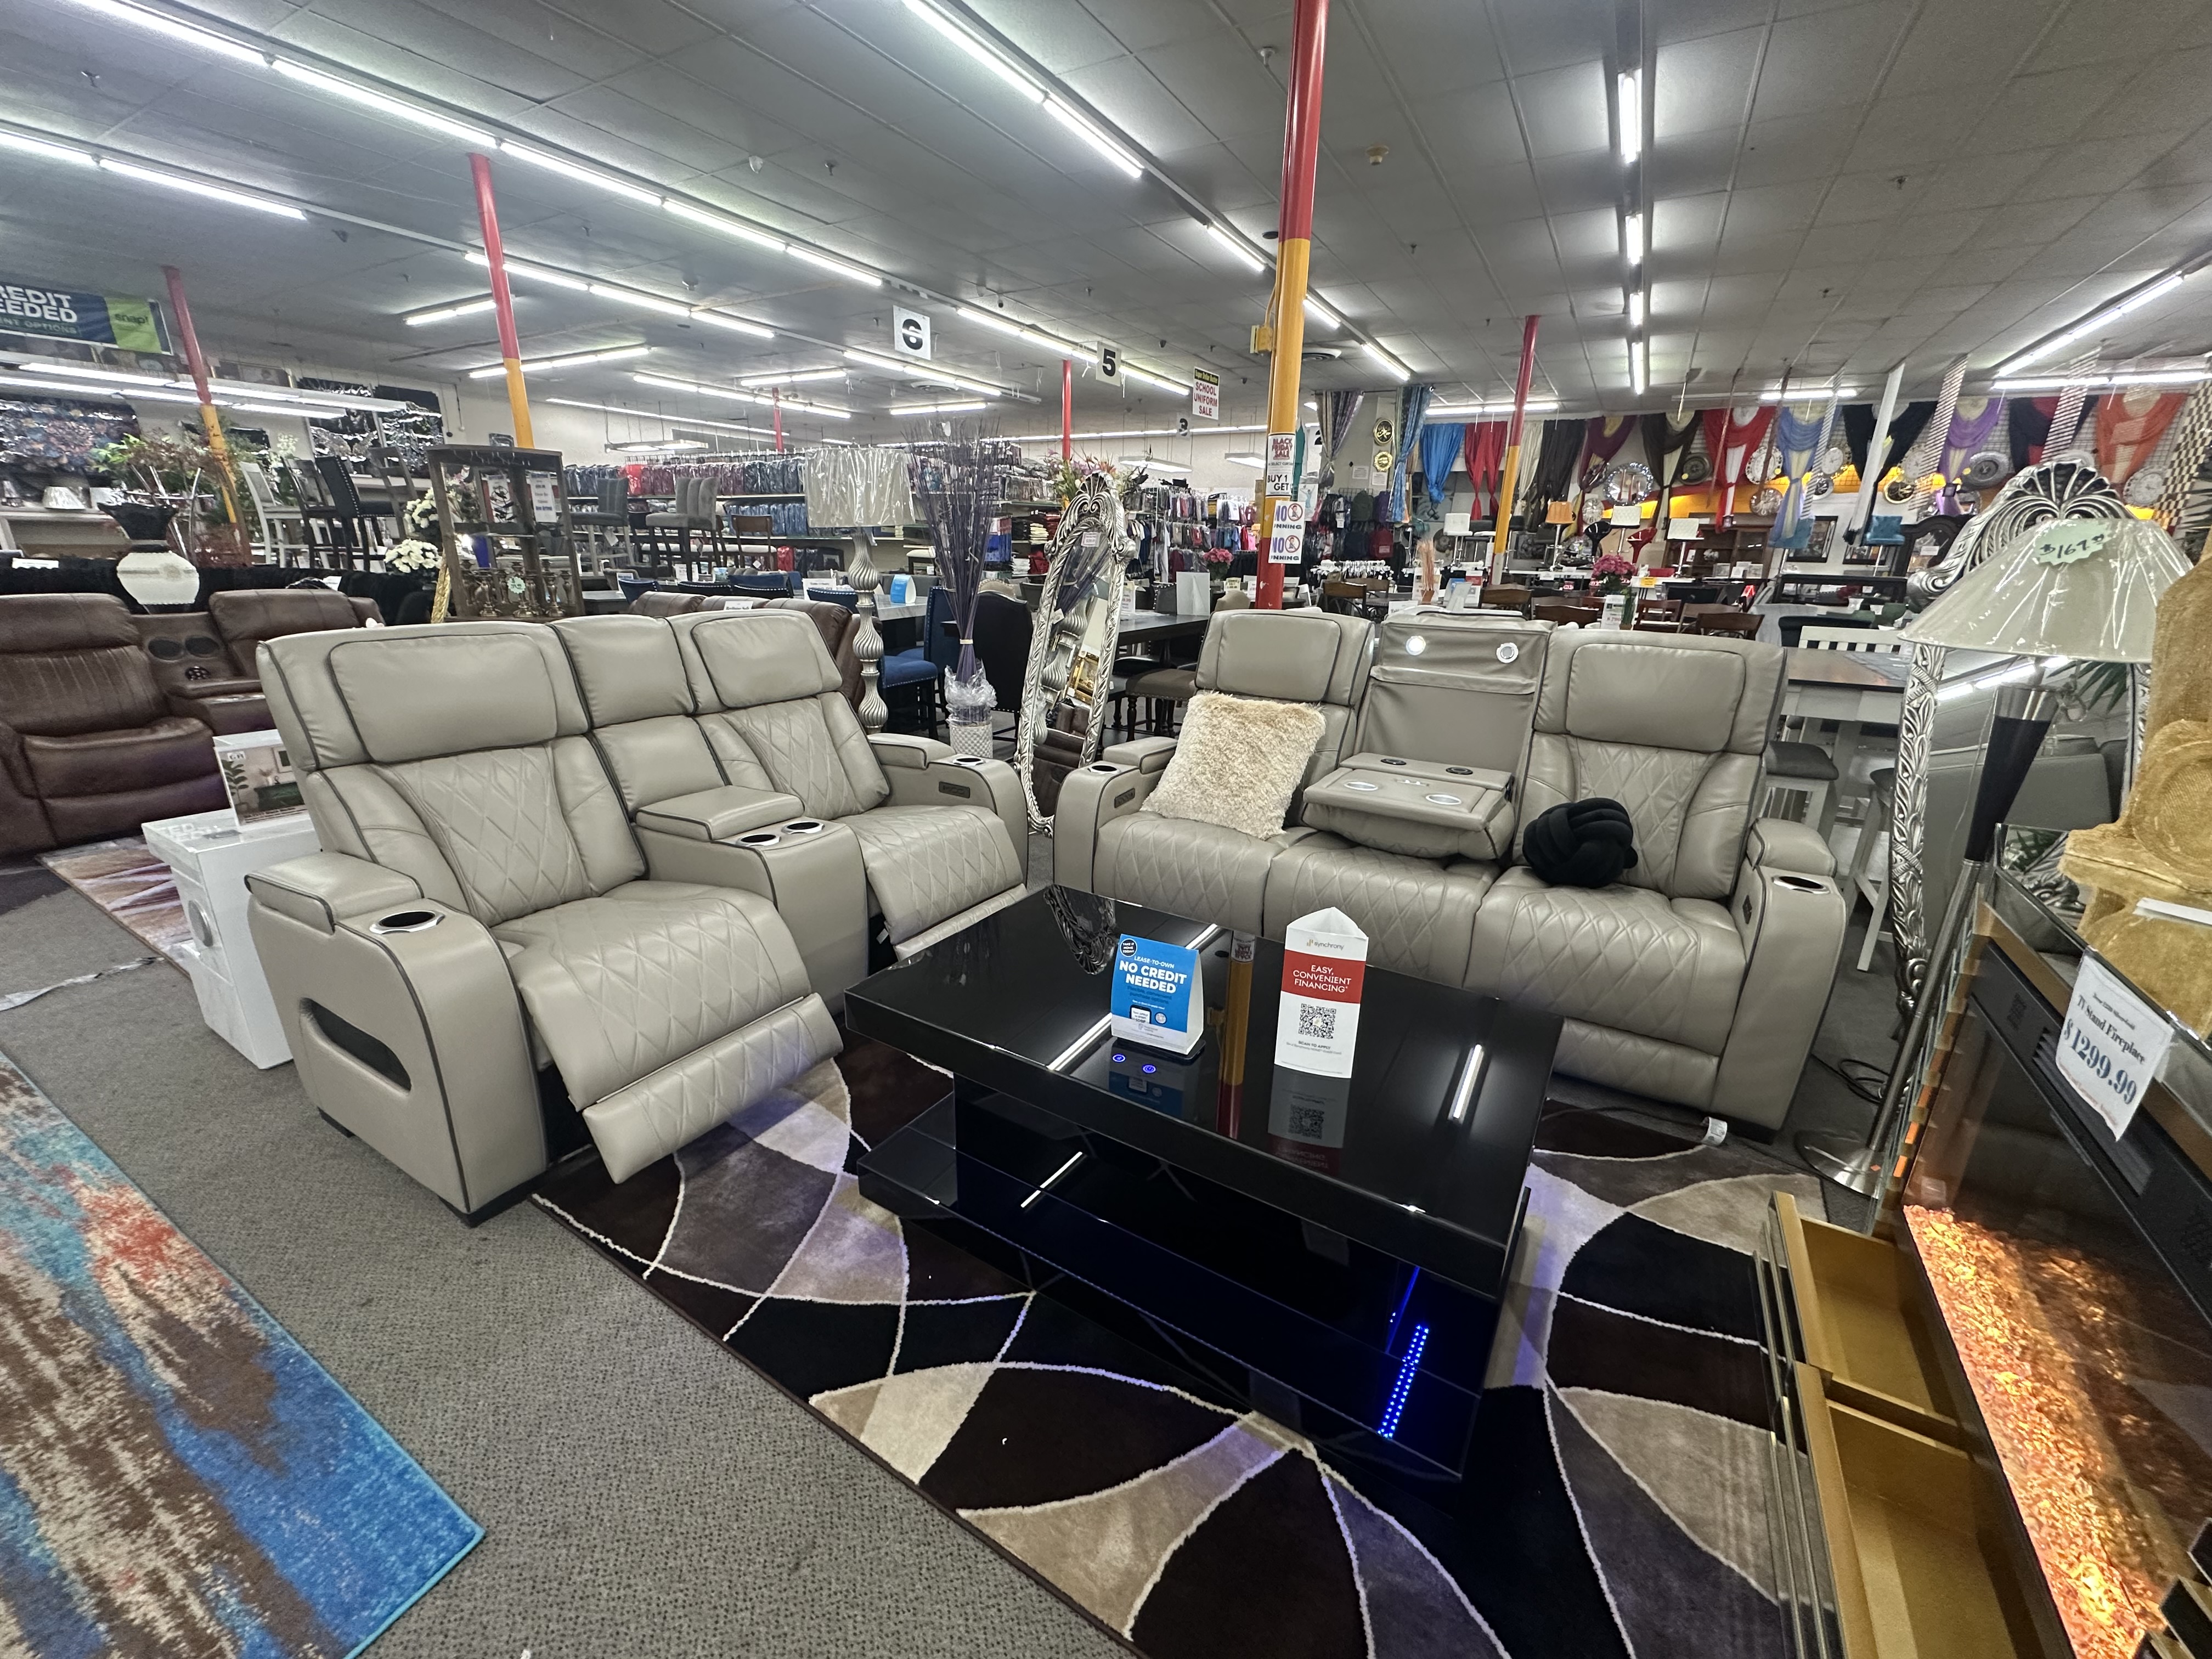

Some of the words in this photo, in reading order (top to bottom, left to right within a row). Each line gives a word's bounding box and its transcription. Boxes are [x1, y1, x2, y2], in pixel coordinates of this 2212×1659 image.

[901, 319, 923, 351] 6
[1102, 348, 1116, 377] 5
[1195, 382, 1216, 396] SCHOOL
[1194, 393, 1217, 407] UNIFORM
[1199, 405, 1212, 416] SALE
[1179, 418, 1188, 436] 3
[1272, 443, 1293, 451] FRIDAY
[1274, 449, 1289, 458] SALE
[1267, 475, 1282, 483] BUY
[1275, 505, 1287, 522] NO
[1272, 538, 1285, 553] NO
[1314, 941, 1344, 951] synchrony
[1134, 956, 1175, 969] LEASE-TO-OWN
[1311, 964, 1334, 975] EASY,
[1119, 960, 1138, 973] NO
[1141, 966, 1187, 984] CREDIT
[1293, 970, 1352, 985] CONVENIENT
[2085, 1005, 2107, 1031] Stand
[2104, 1024, 2145, 1063] Fireplace
